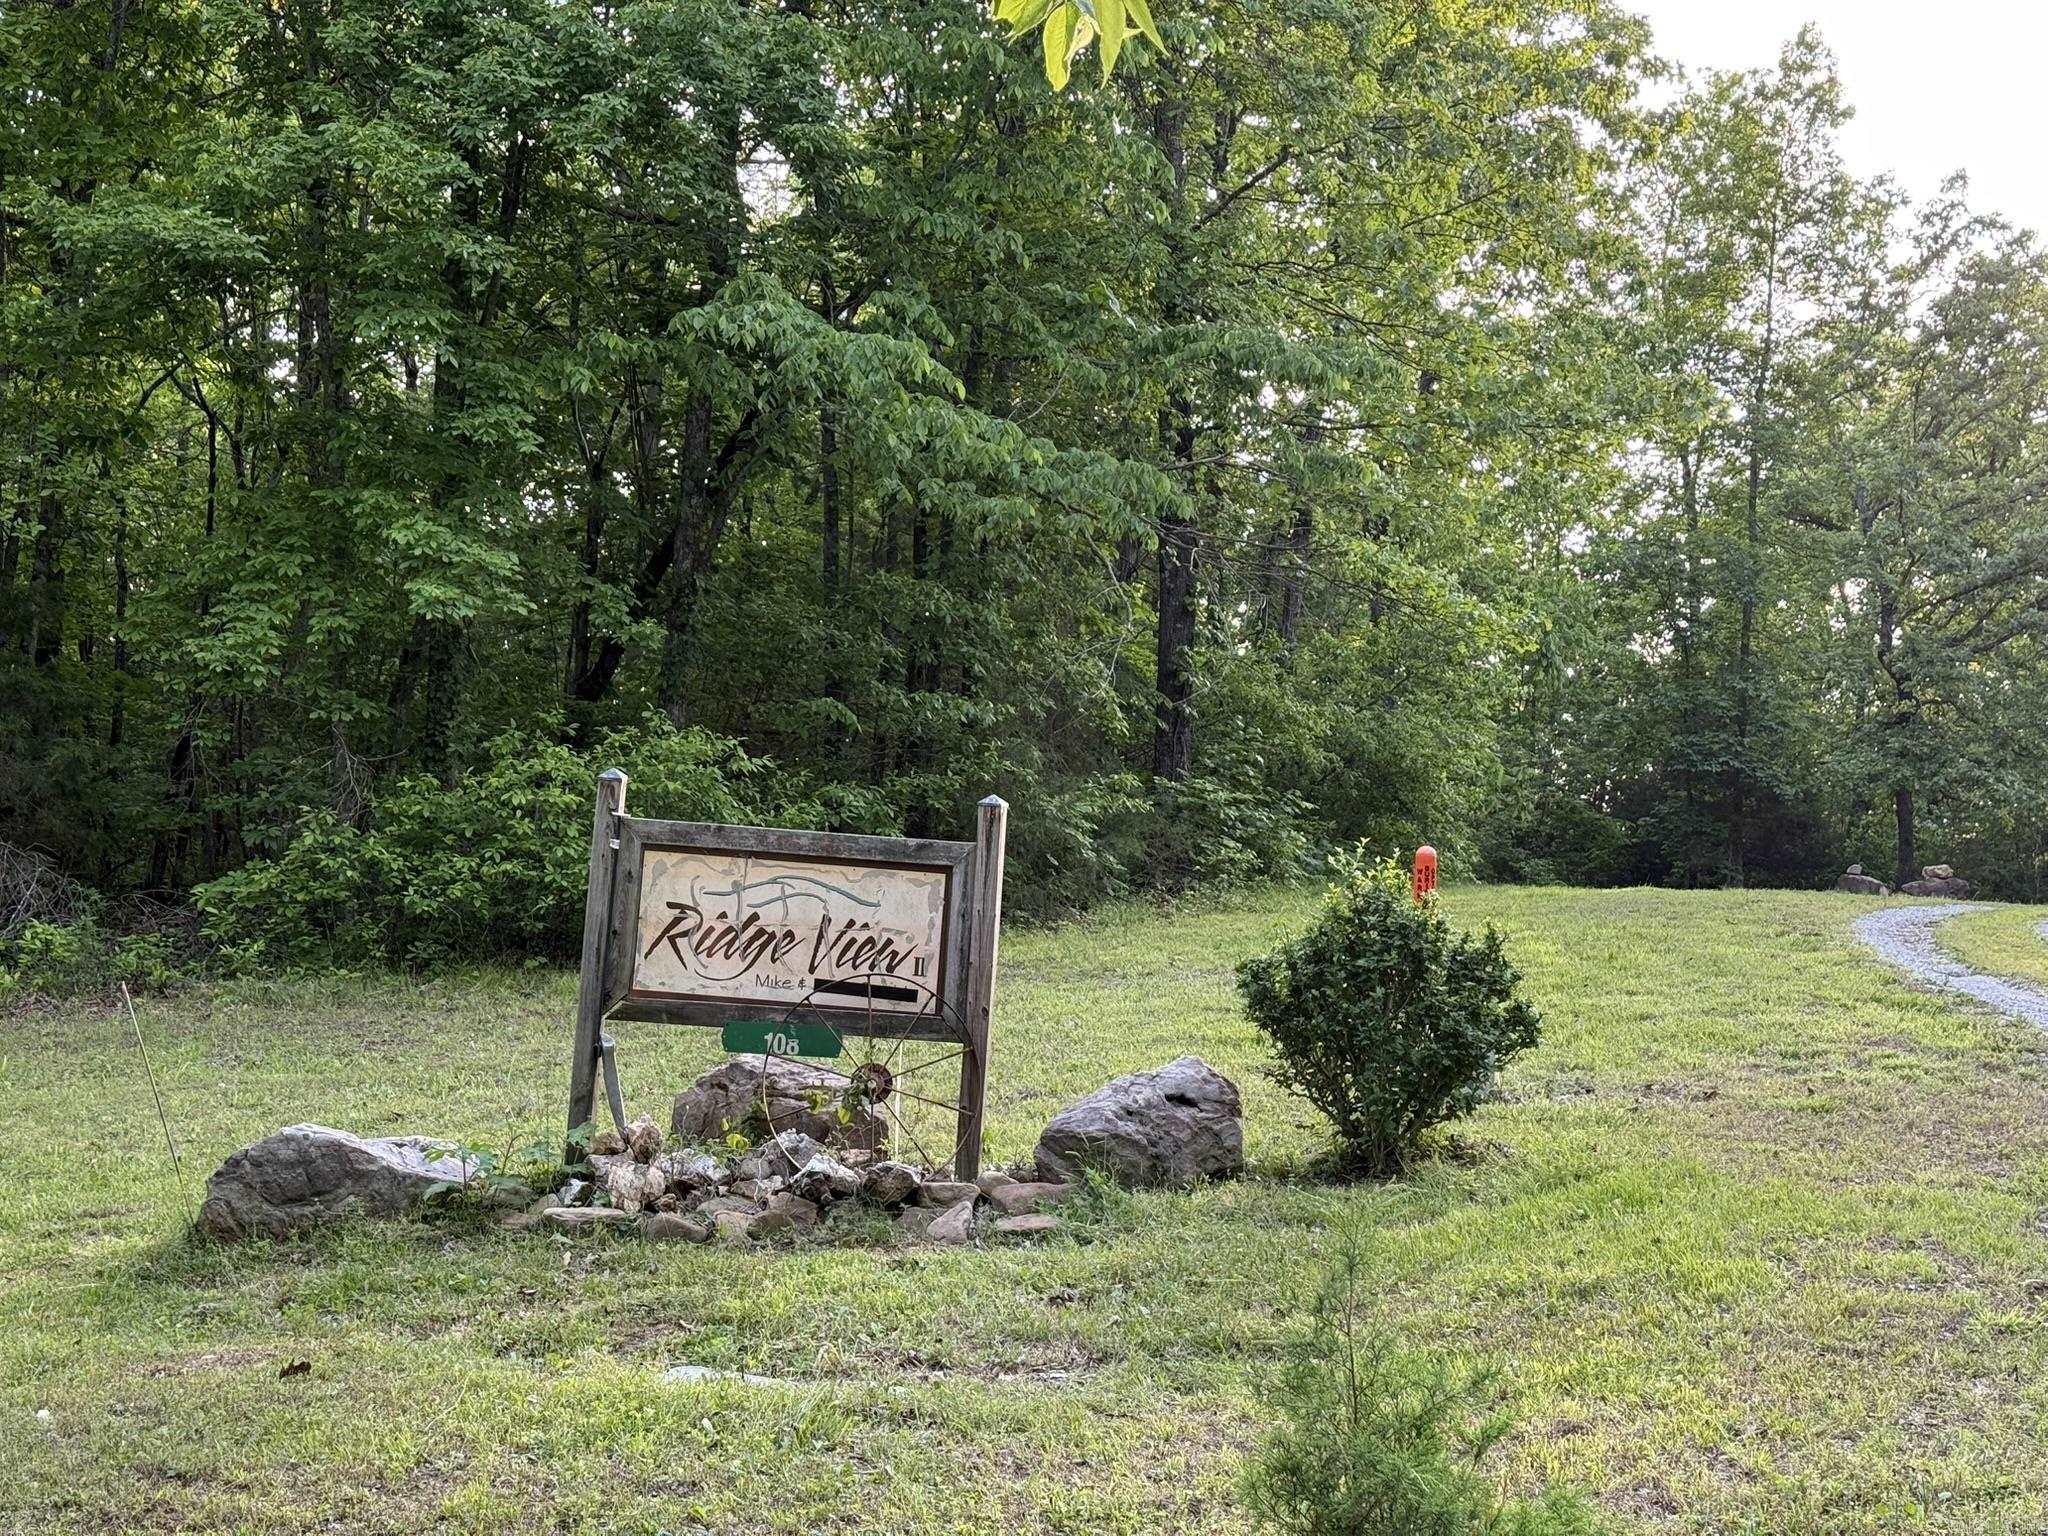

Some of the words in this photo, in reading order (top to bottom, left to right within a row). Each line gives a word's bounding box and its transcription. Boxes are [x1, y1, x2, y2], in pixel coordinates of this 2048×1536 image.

[643, 901, 806, 981] Ridge
[807, 912, 918, 975] View
[755, 973, 791, 990] Mike
